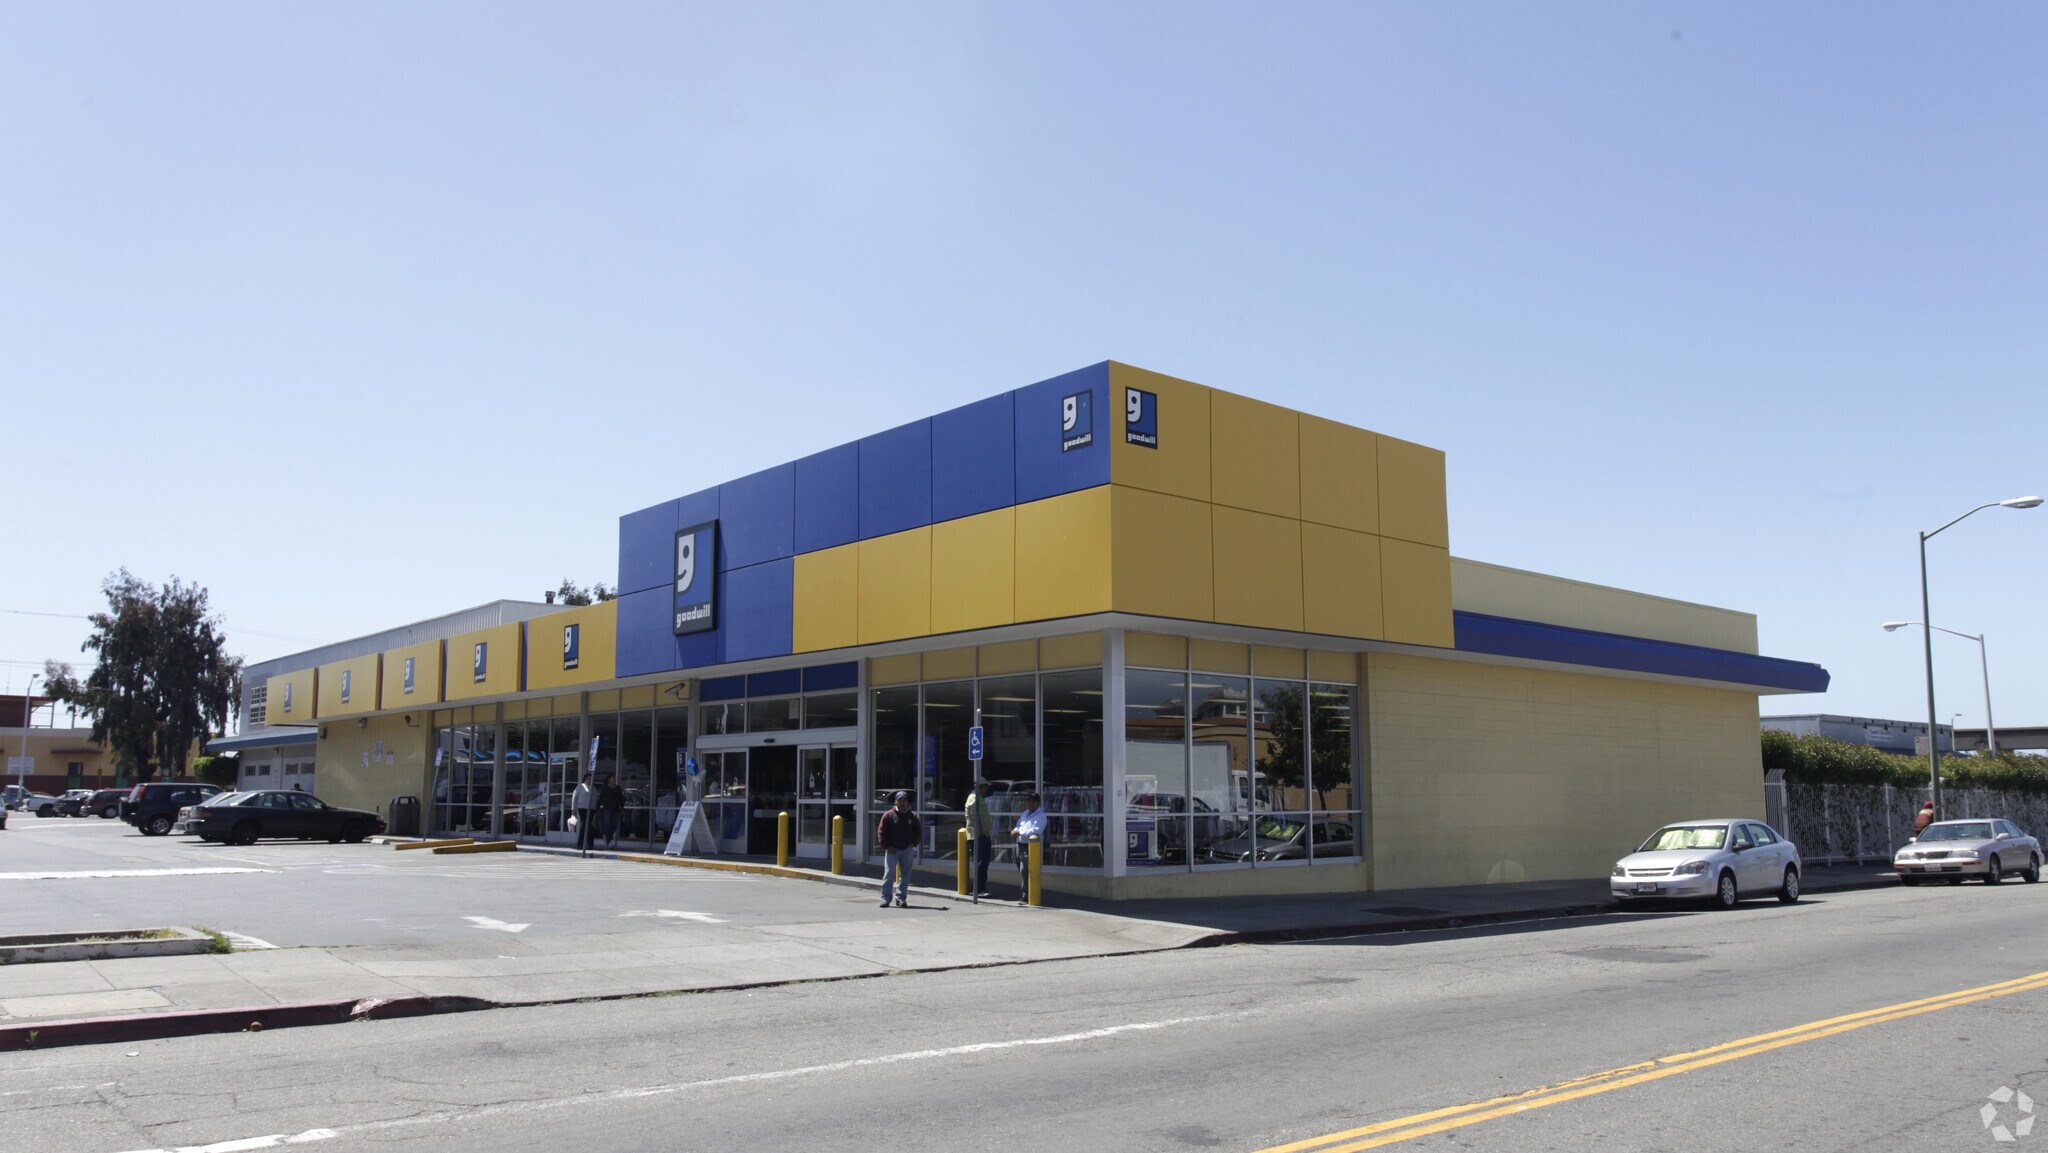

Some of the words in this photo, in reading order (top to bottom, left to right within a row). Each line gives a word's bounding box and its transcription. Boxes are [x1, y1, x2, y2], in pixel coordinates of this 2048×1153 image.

[1063, 433, 1092, 451] goodwill
[1127, 433, 1156, 444] goodwill
[676, 603, 711, 628] goodwill
